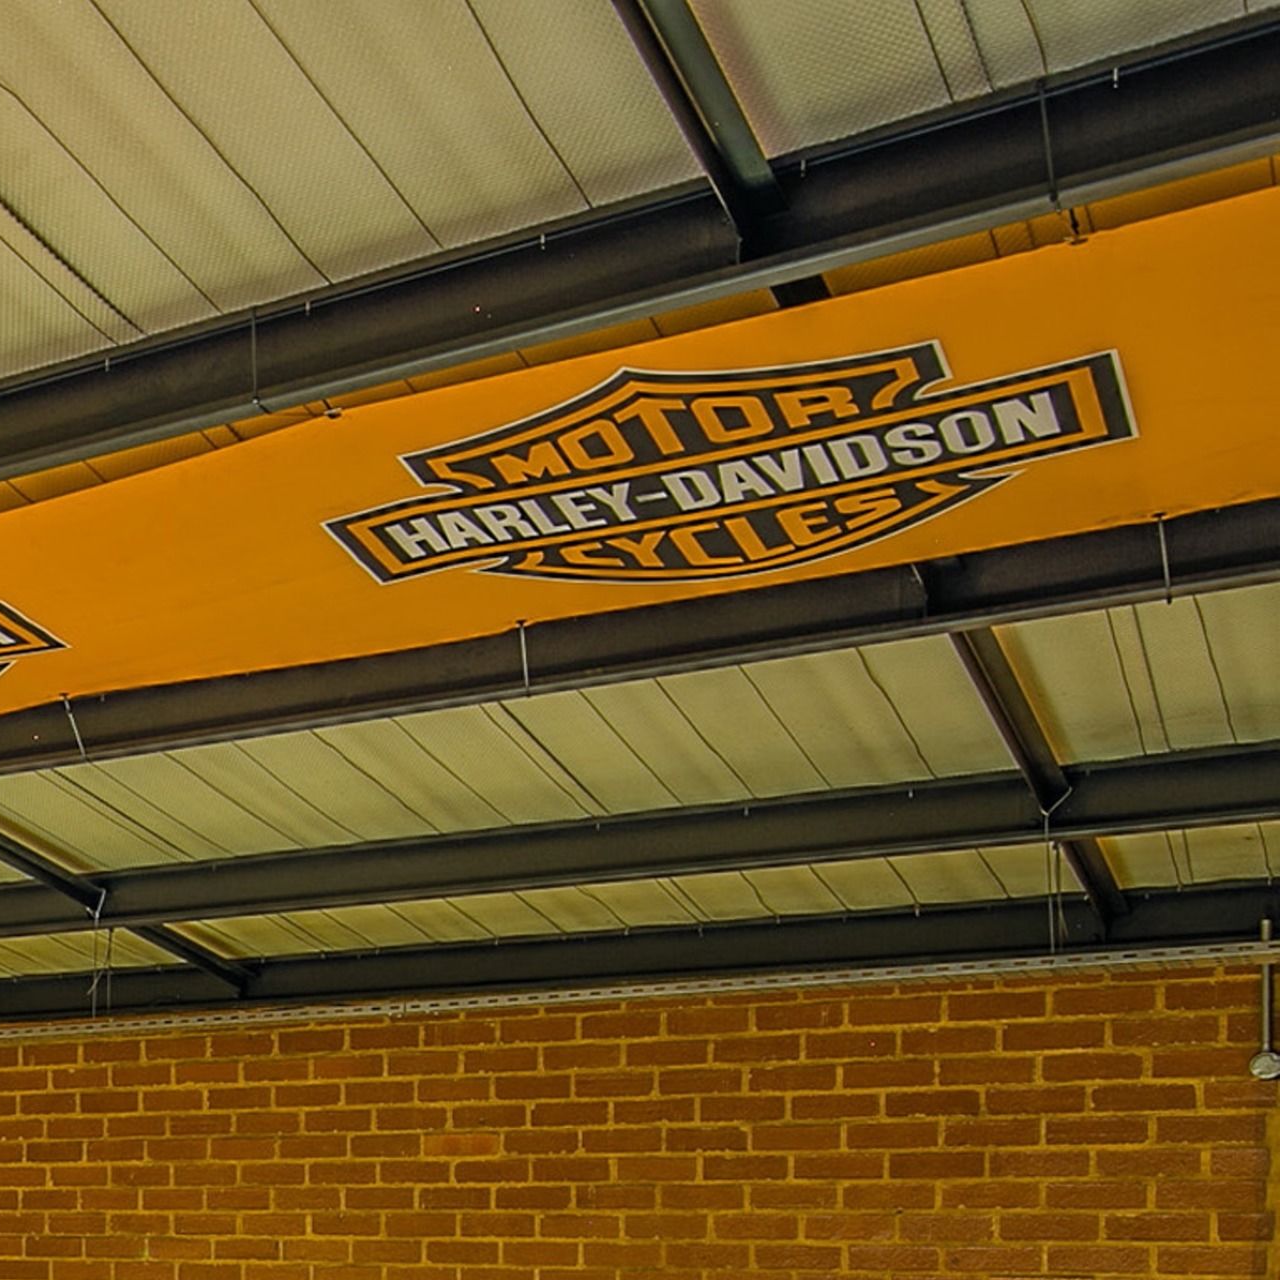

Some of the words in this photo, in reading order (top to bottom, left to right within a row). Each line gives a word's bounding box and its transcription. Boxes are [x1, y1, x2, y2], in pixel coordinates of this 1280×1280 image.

[385, 393, 1061, 560] HARLEY-DAVIDSON
[490, 384, 861, 485] MOTOR
[561, 486, 901, 569] CYCLES
